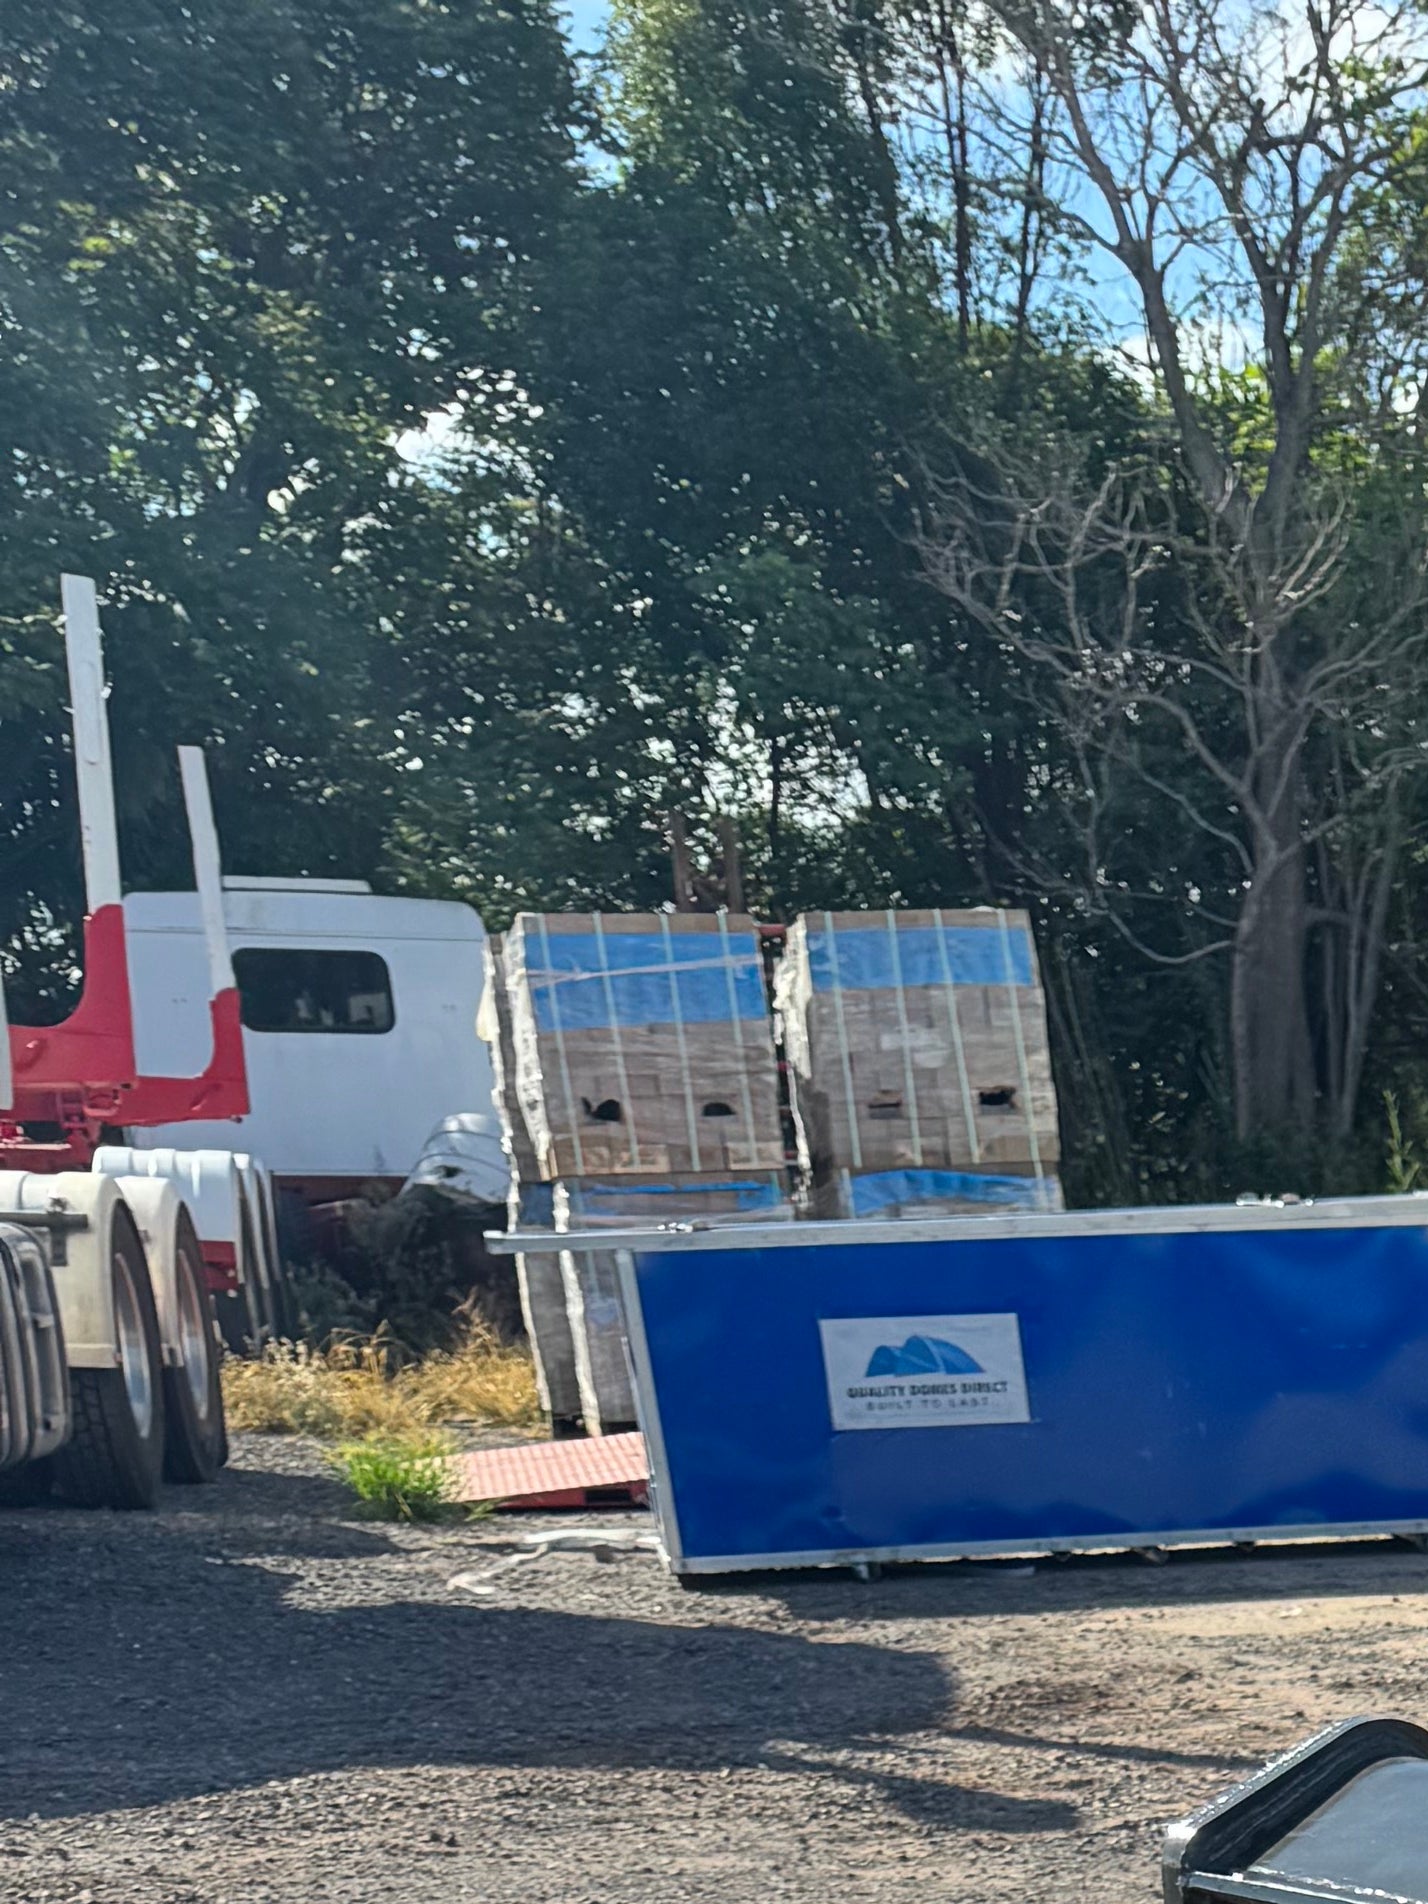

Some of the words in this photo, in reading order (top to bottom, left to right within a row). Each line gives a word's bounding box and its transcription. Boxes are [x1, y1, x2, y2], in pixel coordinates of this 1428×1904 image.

[847, 1385, 905, 1398] QUALITY
[961, 1381, 1008, 1394] DIRECT
[866, 1399, 913, 1411] BUILT
[920, 1399, 943, 1410] TO
[949, 1397, 989, 1408] LAST
